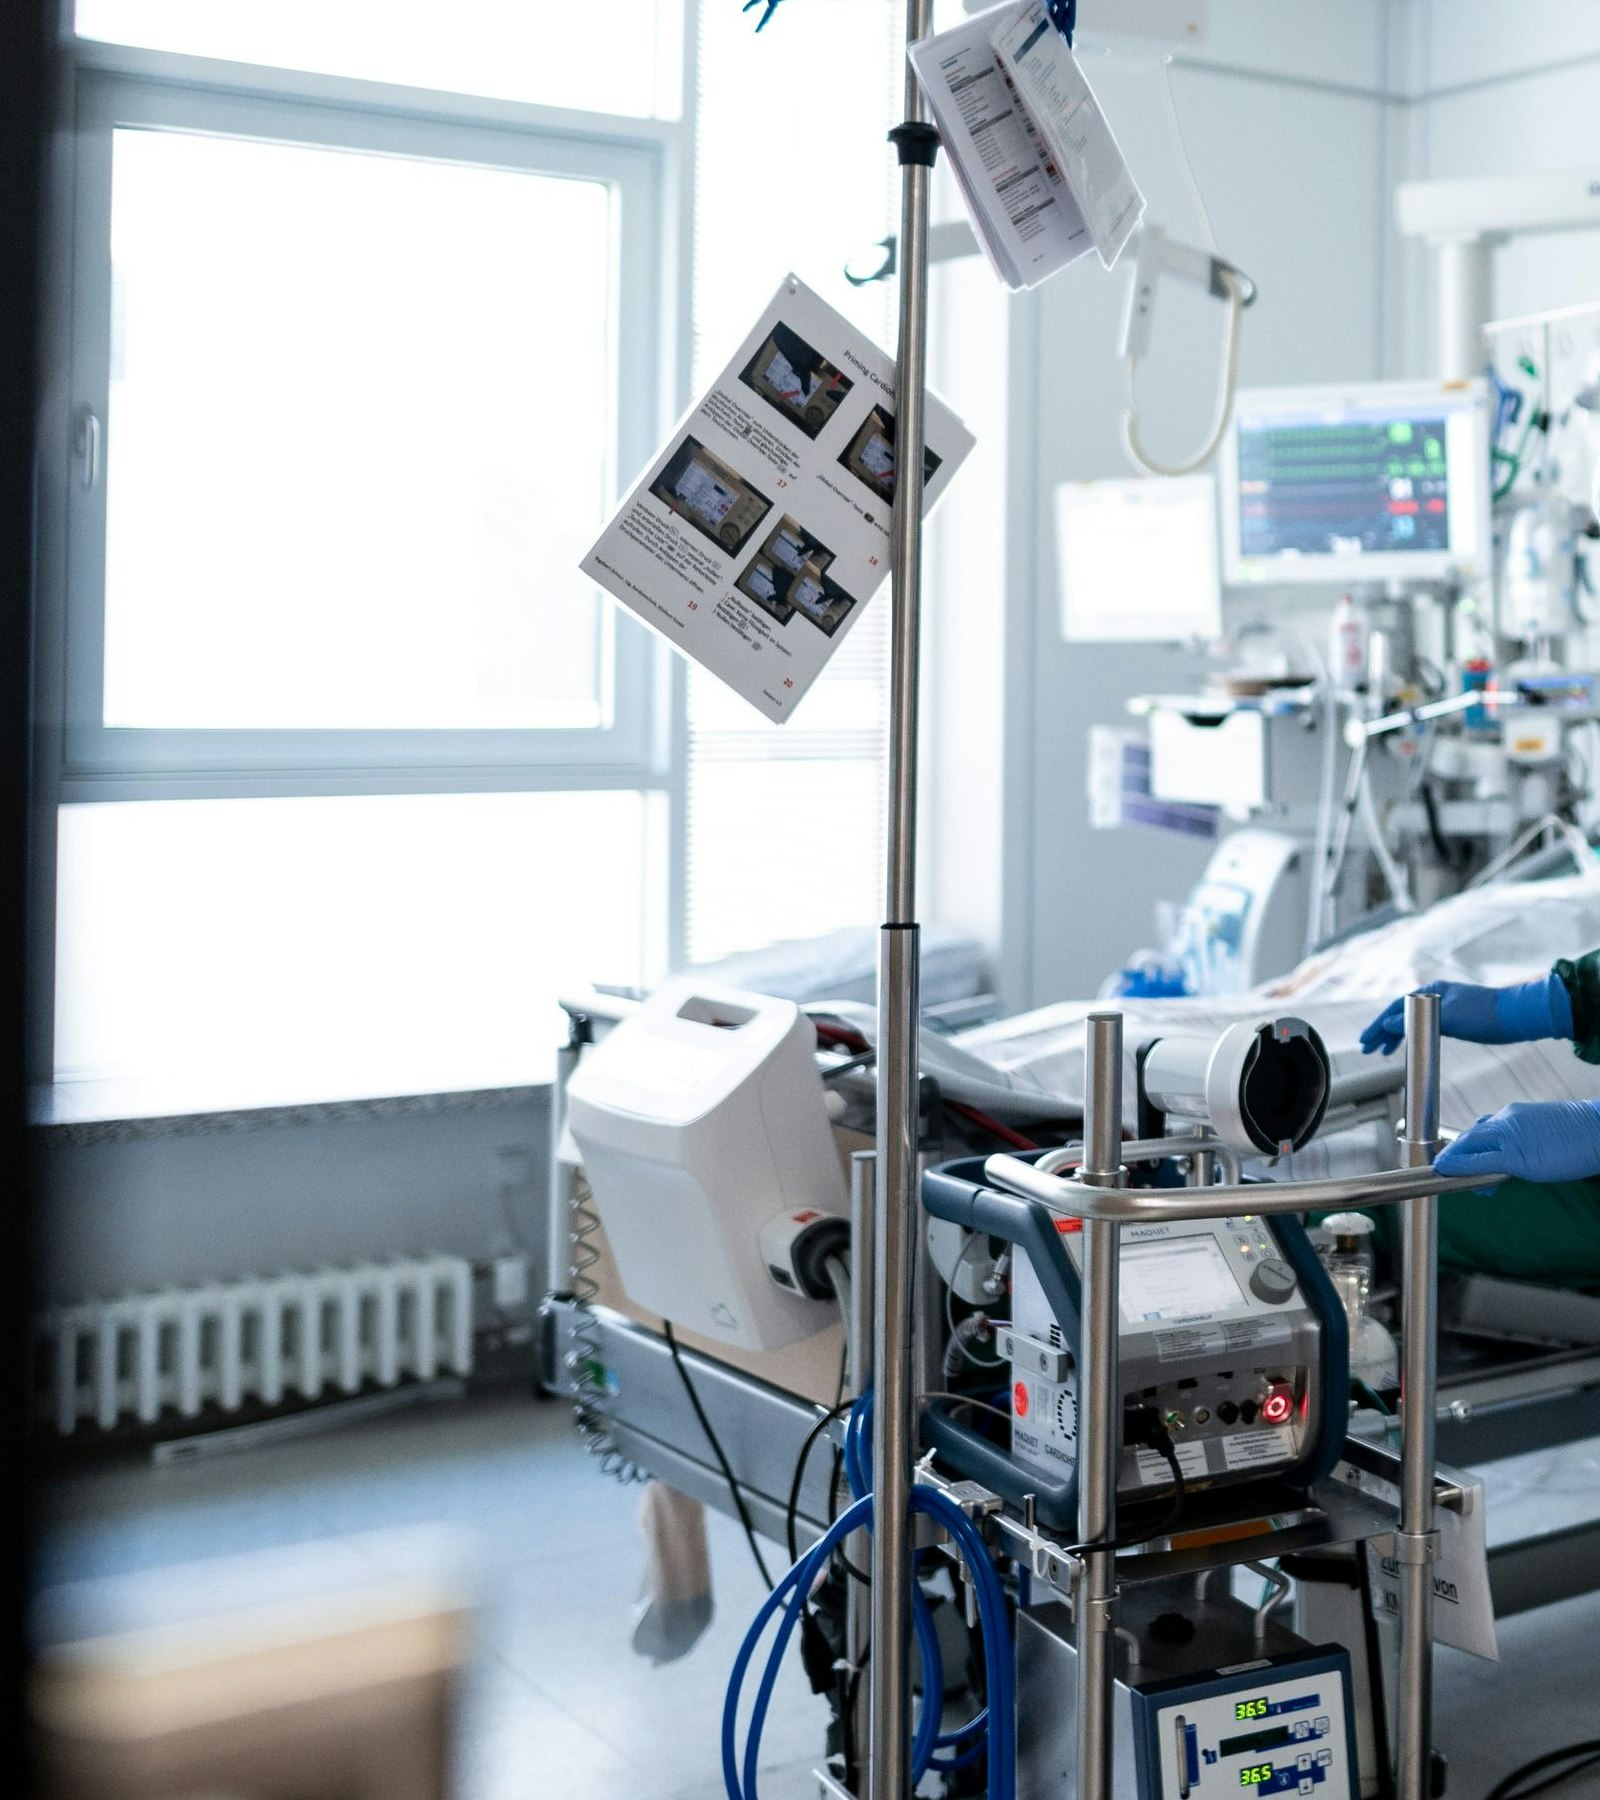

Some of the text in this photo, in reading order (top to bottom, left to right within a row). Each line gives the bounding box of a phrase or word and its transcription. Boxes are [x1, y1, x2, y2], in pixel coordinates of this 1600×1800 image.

[841, 350, 899, 399] Priming Cardioh
[776, 477, 788, 489] 17
[868, 555, 879, 566] 18
[687, 599, 699, 611] 19
[782, 676, 794, 689] 20
[1130, 1226, 1170, 1238] MAQUET
